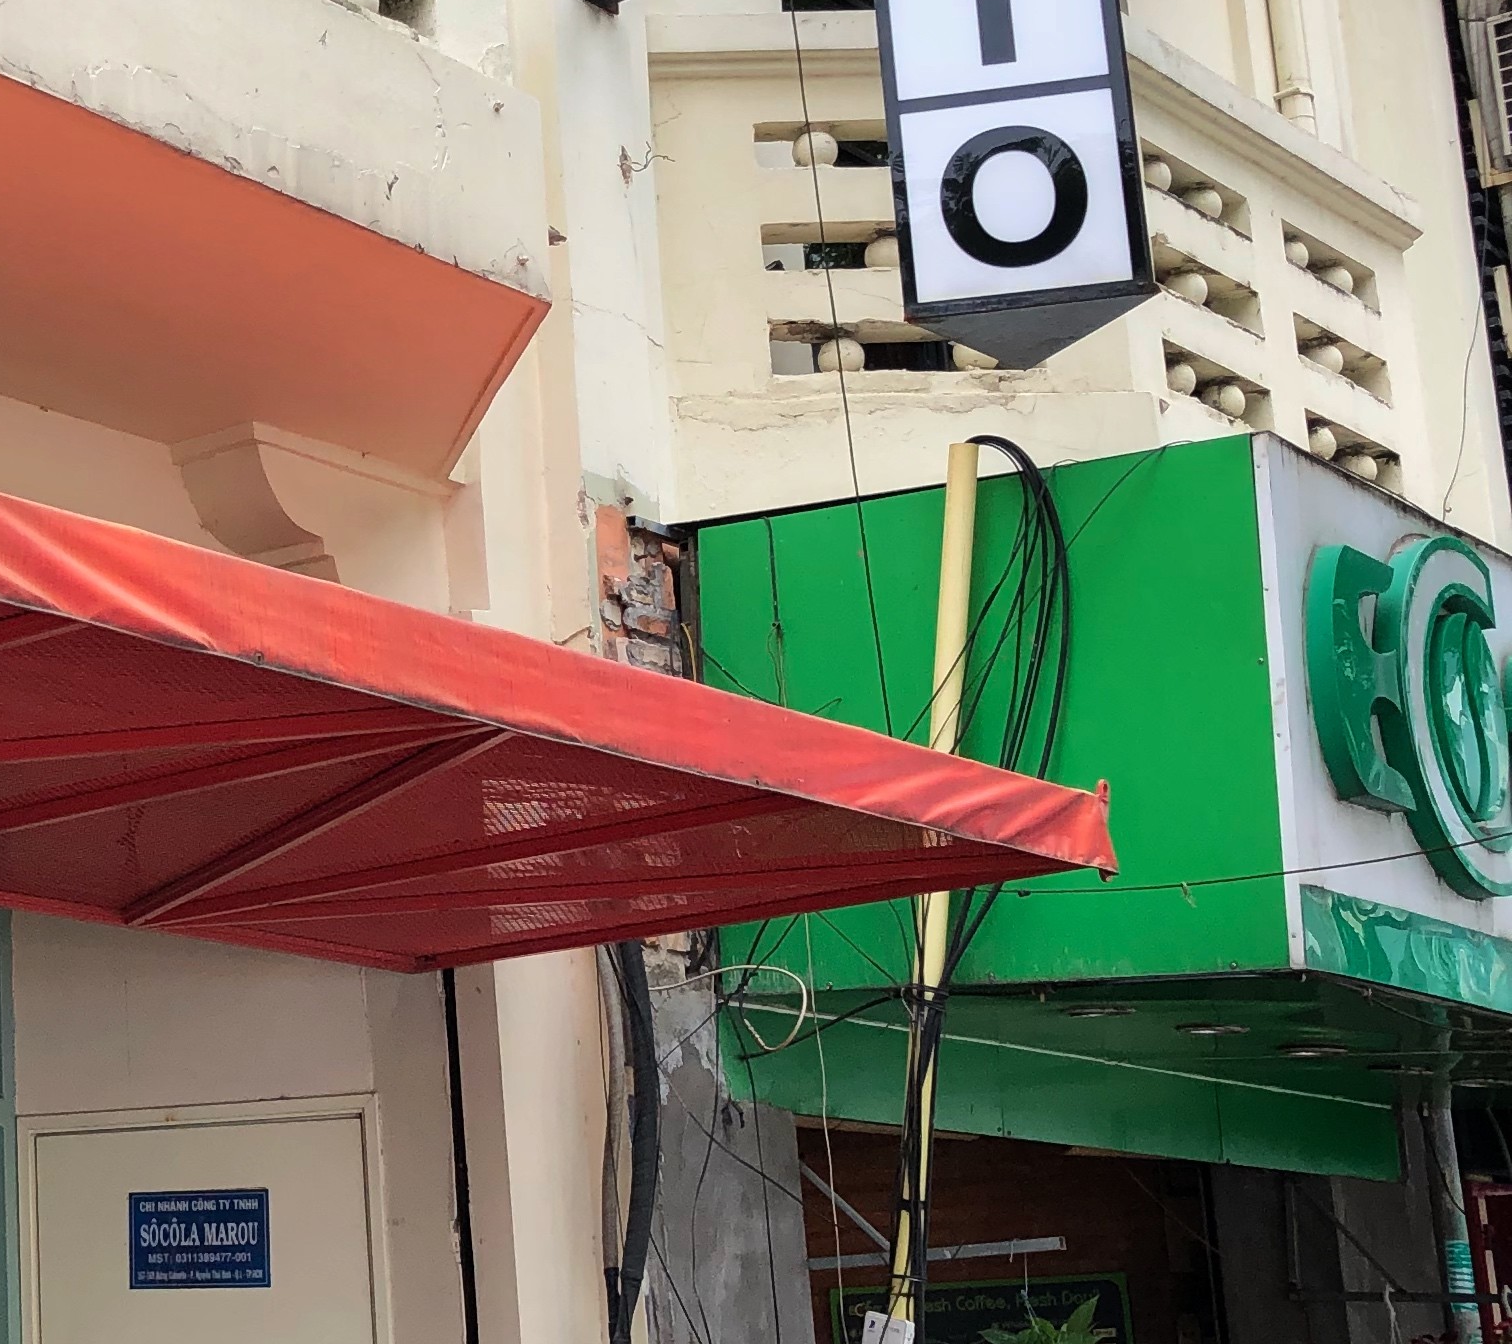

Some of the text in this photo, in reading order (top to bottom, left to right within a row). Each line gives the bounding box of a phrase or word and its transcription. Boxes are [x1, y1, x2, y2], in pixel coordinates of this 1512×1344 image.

[219, 1199, 230, 1211] TY
[233, 1199, 258, 1210] TNHH
[140, 1217, 258, 1247] SÔCÔLA MAROU
